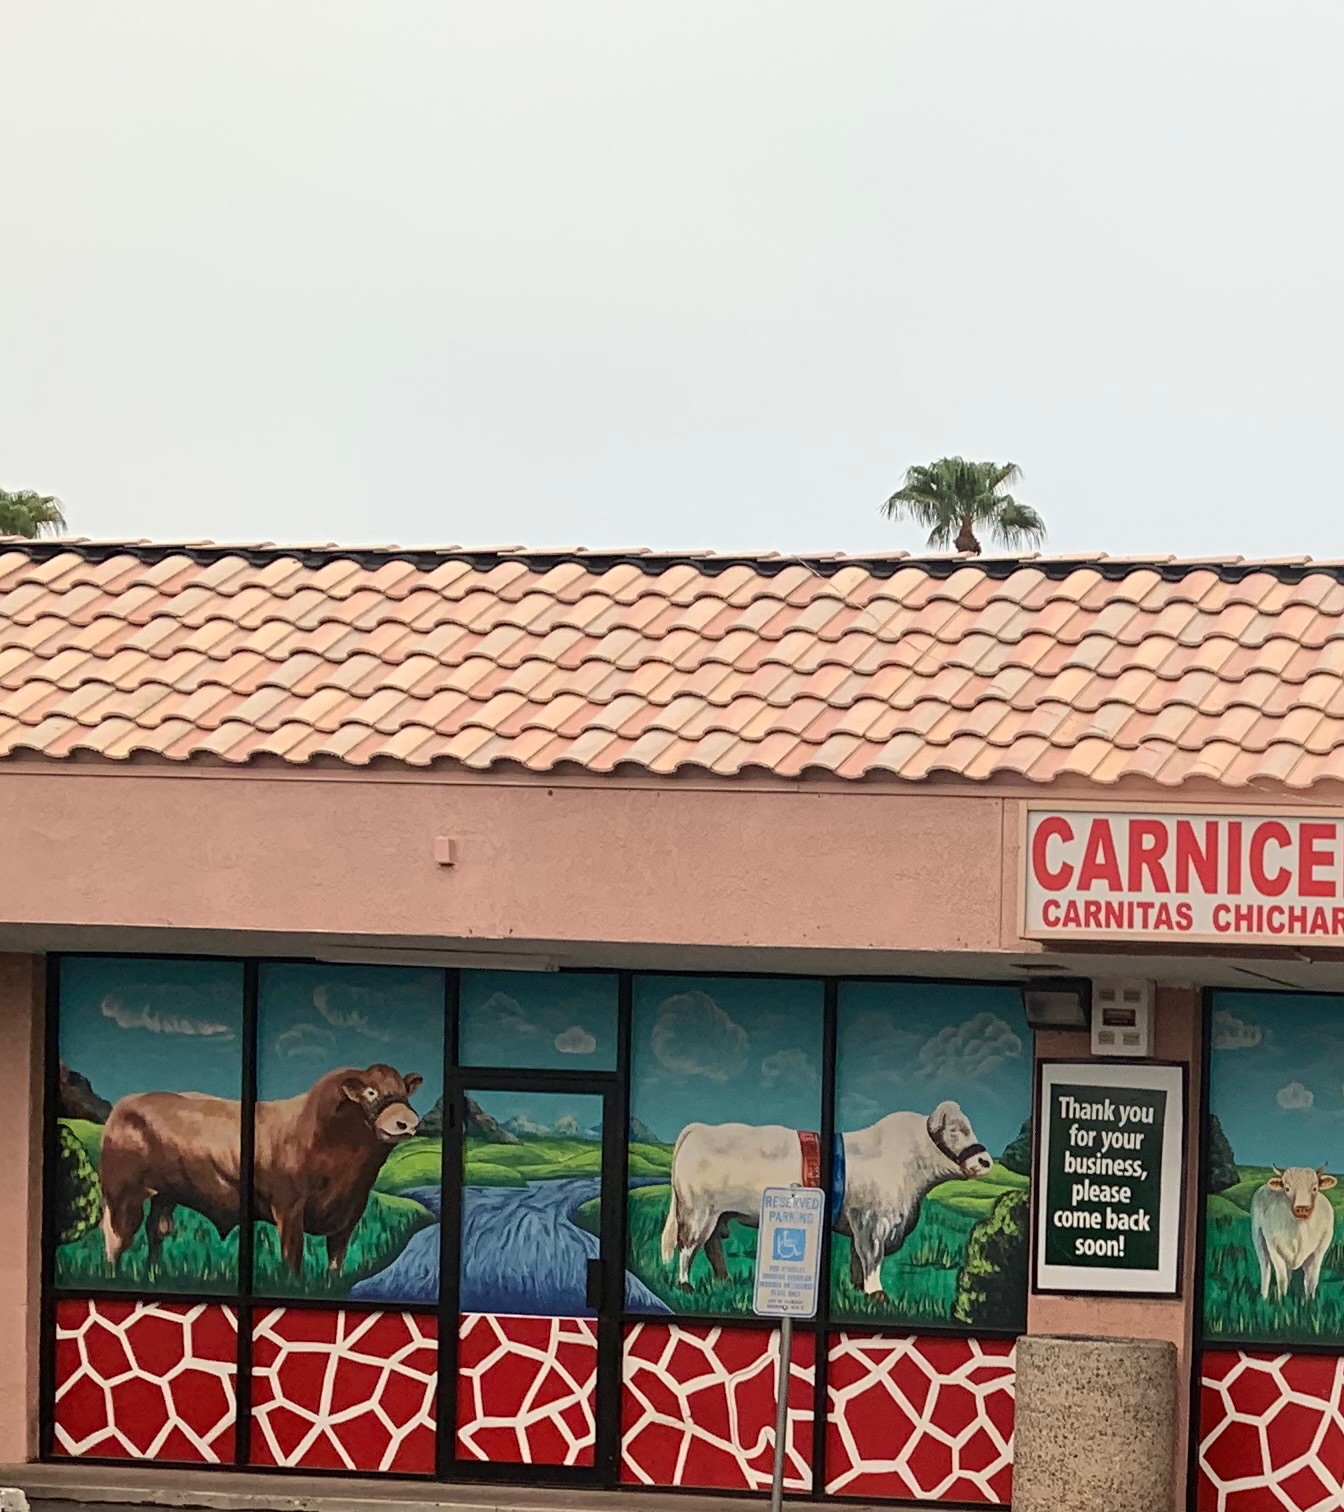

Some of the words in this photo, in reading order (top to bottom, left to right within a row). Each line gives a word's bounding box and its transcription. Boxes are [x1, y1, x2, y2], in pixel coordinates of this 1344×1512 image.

[1042, 900, 1193, 931] CARNITAS
[1058, 1096, 1116, 1120] Thank
[1118, 1105, 1155, 1128] you
[1068, 1124, 1096, 1147] for
[1101, 1130, 1144, 1153] your
[1064, 1151, 1148, 1180] business,
[765, 1196, 819, 1210] RESERVED
[1071, 1178, 1132, 1206] please
[769, 1211, 814, 1224] PARKING
[1053, 1208, 1102, 1229] come
[1105, 1209, 1150, 1232] back
[1075, 1235, 1125, 1257] soon!
